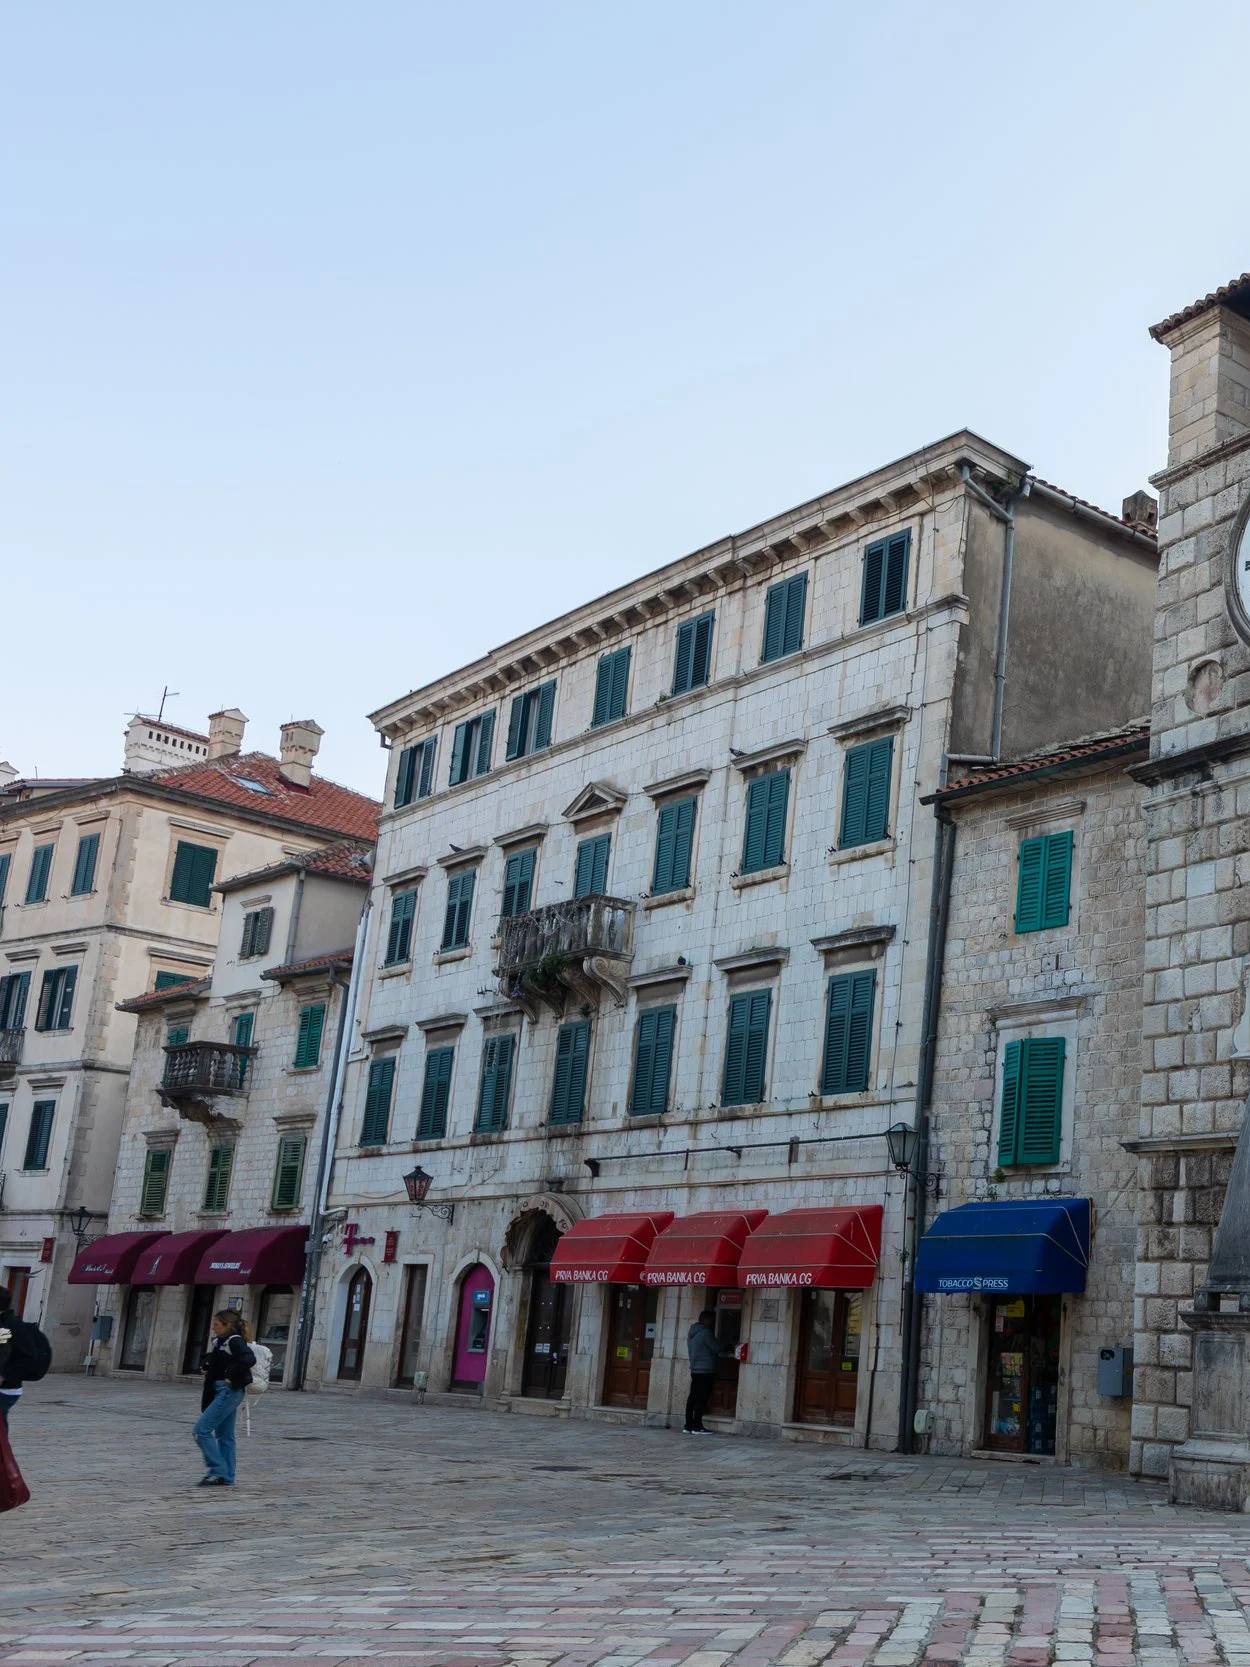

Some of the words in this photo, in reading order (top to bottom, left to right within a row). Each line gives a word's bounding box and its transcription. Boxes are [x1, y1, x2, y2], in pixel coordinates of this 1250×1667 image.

[554, 1270, 572, 1281] PRVA
[573, 1270, 597, 1281] BANKA
[597, 1270, 609, 1281] CG
[647, 1272, 666, 1283] PRVA
[666, 1272, 692, 1283] BANKA
[693, 1271, 706, 1283] CG
[745, 1273, 767, 1285] PRVA
[767, 1273, 798, 1284] BANKA
[799, 1272, 812, 1284] CG
[938, 1279, 973, 1288] TOBACCO
[983, 1279, 1008, 1288] PRESS
